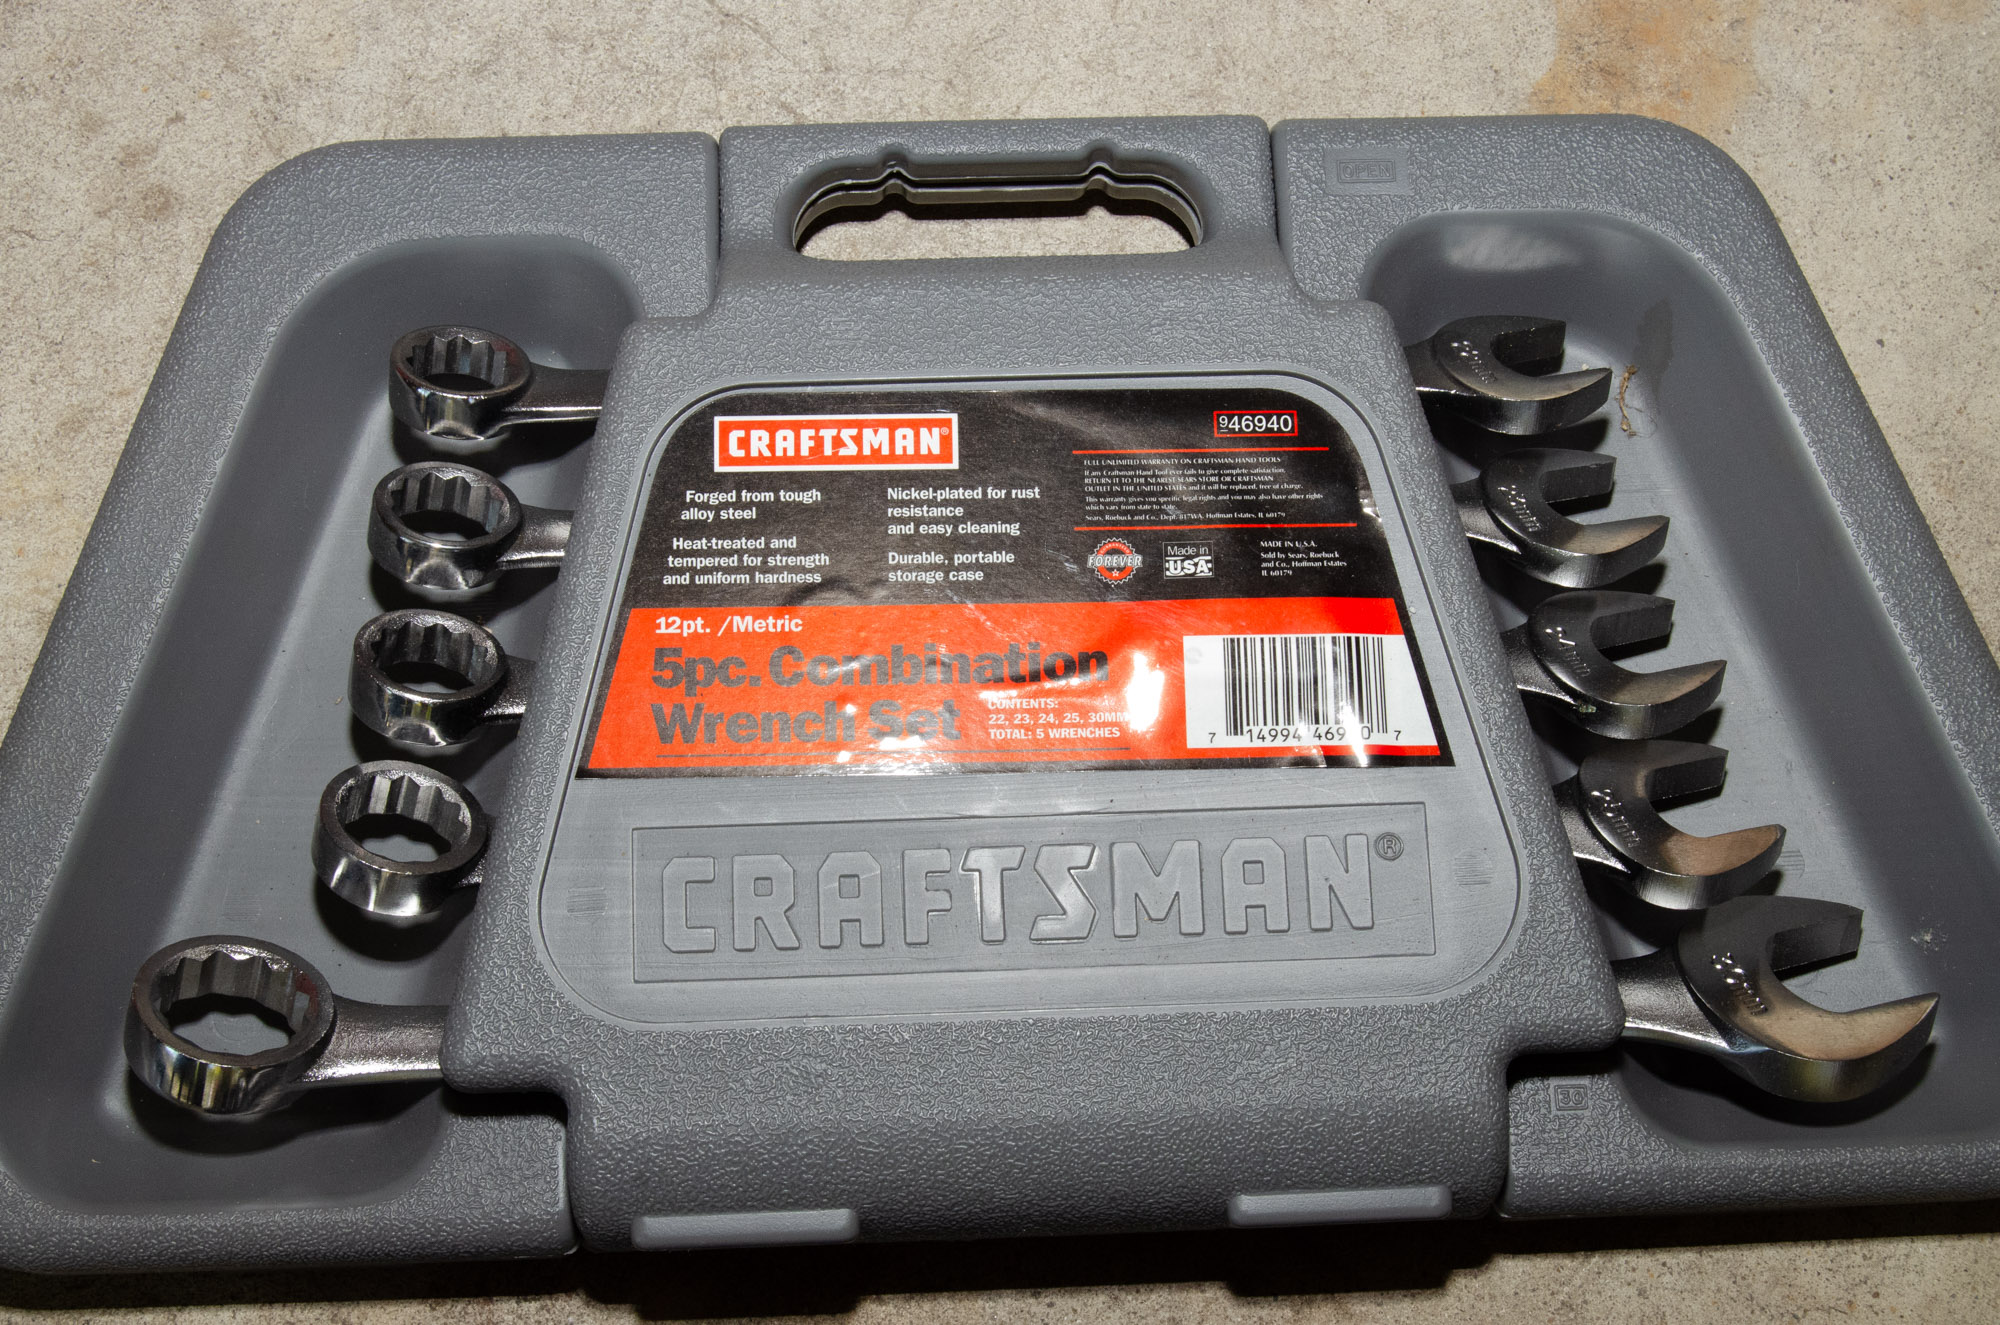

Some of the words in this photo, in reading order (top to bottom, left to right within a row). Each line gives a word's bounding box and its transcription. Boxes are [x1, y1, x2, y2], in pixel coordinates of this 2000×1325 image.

[1343, 163, 1390, 178] OPEN
[1220, 415, 1292, 432] 946940
[686, 490, 736, 505] Forged
[741, 490, 775, 502] from
[779, 489, 820, 504] tough
[888, 487, 983, 502] Nickel-plated
[986, 487, 1006, 499] for
[1011, 487, 1040, 499] rust
[681, 507, 715, 522] alloy
[720, 507, 756, 519] steel
[888, 505, 963, 517] resistance
[888, 523, 914, 534] and
[919, 523, 952, 536] easy
[958, 521, 1020, 536] cleaning
[673, 537, 764, 550] Heat-treated
[771, 536, 796, 548] and
[1168, 546, 1196, 555] Made
[1200, 545, 1208, 554] in
[668, 555, 738, 569] tempered
[743, 554, 762, 567] for
[767, 553, 829, 568] strength
[888, 552, 948, 566] Durable,
[954, 551, 1014, 566] portable
[1088, 556, 1142, 566] FOREVER
[1169, 560, 1210, 574] USA
[663, 572, 689, 584] and
[695, 571, 749, 584] uniform
[755, 571, 821, 583] hardness
[888, 570, 943, 584] storage
[949, 569, 983, 581] case
[656, 616, 710, 637] 12pt.
[717, 615, 802, 636] /Metric
[652, 647, 761, 697] 5pc.
[769, 642, 1109, 687] Combination
[988, 698, 1058, 710] CONTENTS:
[651, 701, 855, 745] Wrench
[869, 700, 962, 741] Set
[989, 713, 1009, 725] 22,
[1014, 713, 1034, 725] 23,
[1038, 713, 1059, 725] 24,
[1063, 712, 1083, 724] 25,
[989, 729, 1032, 739] TOTAL:
[1036, 728, 1044, 738] 5
[1048, 727, 1120, 738] WRENCHES
[1209, 732, 1216, 743] 7
[1246, 728, 1302, 742] 14994
[1313, 727, 1371, 740] 4690
[1393, 731, 1401, 741] 7
[1560, 1089, 1584, 1105] 30
